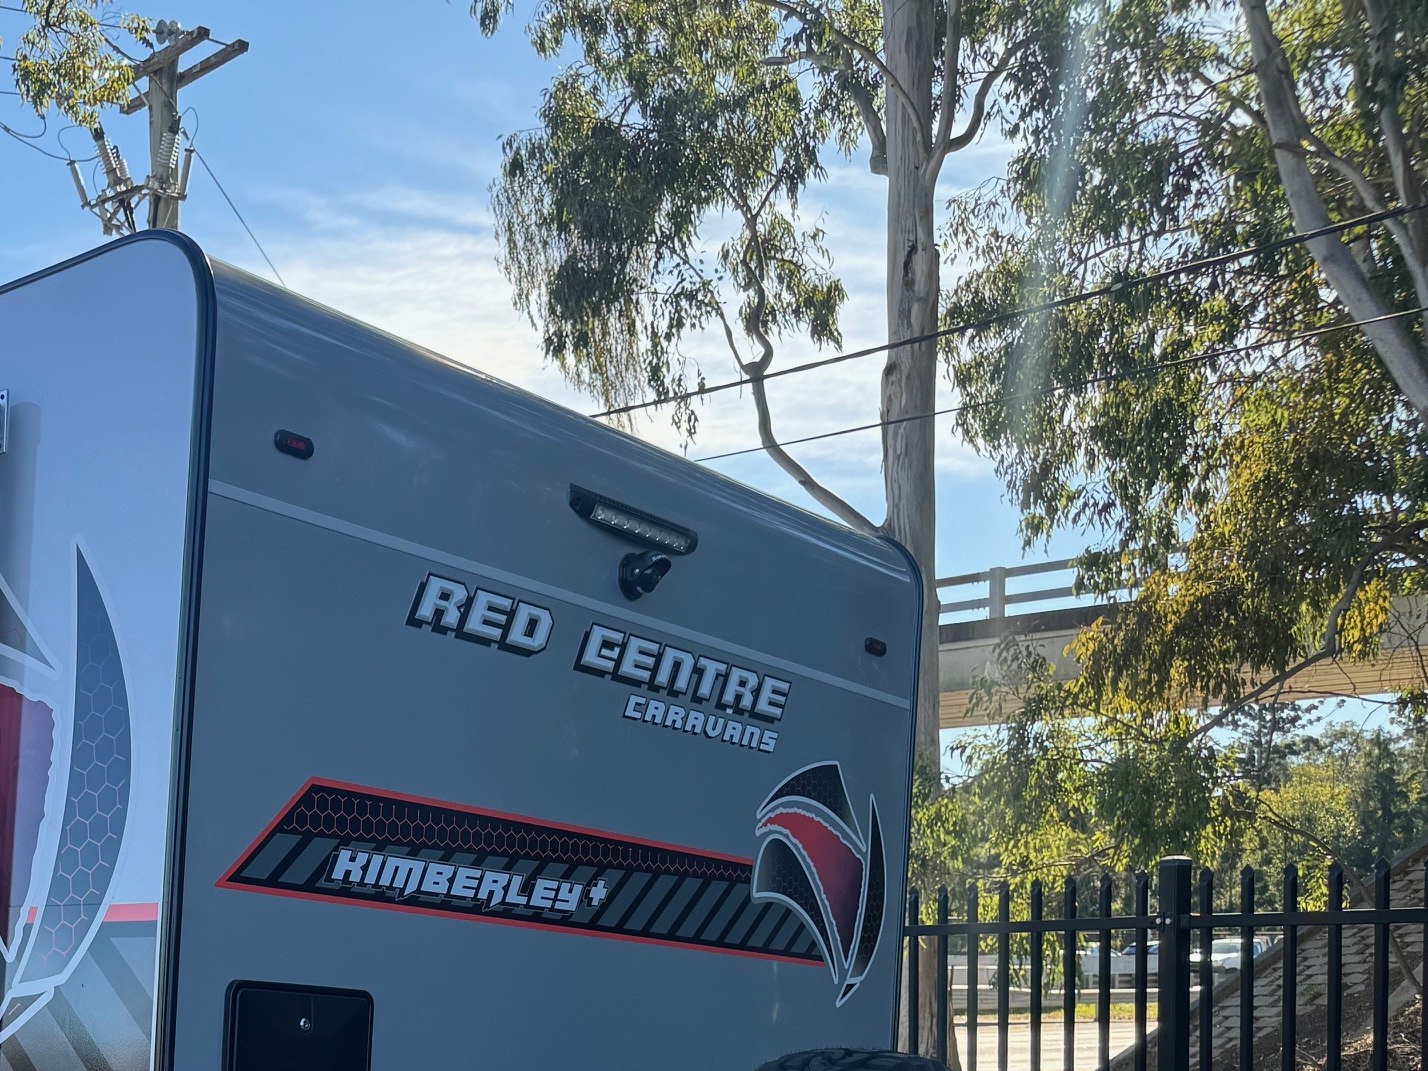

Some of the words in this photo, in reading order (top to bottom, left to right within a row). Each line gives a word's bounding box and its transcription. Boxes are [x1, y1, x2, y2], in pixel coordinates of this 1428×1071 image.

[410, 573, 554, 655] RED
[576, 622, 792, 720] CENTRE
[623, 694, 779, 753] CARAVANS
